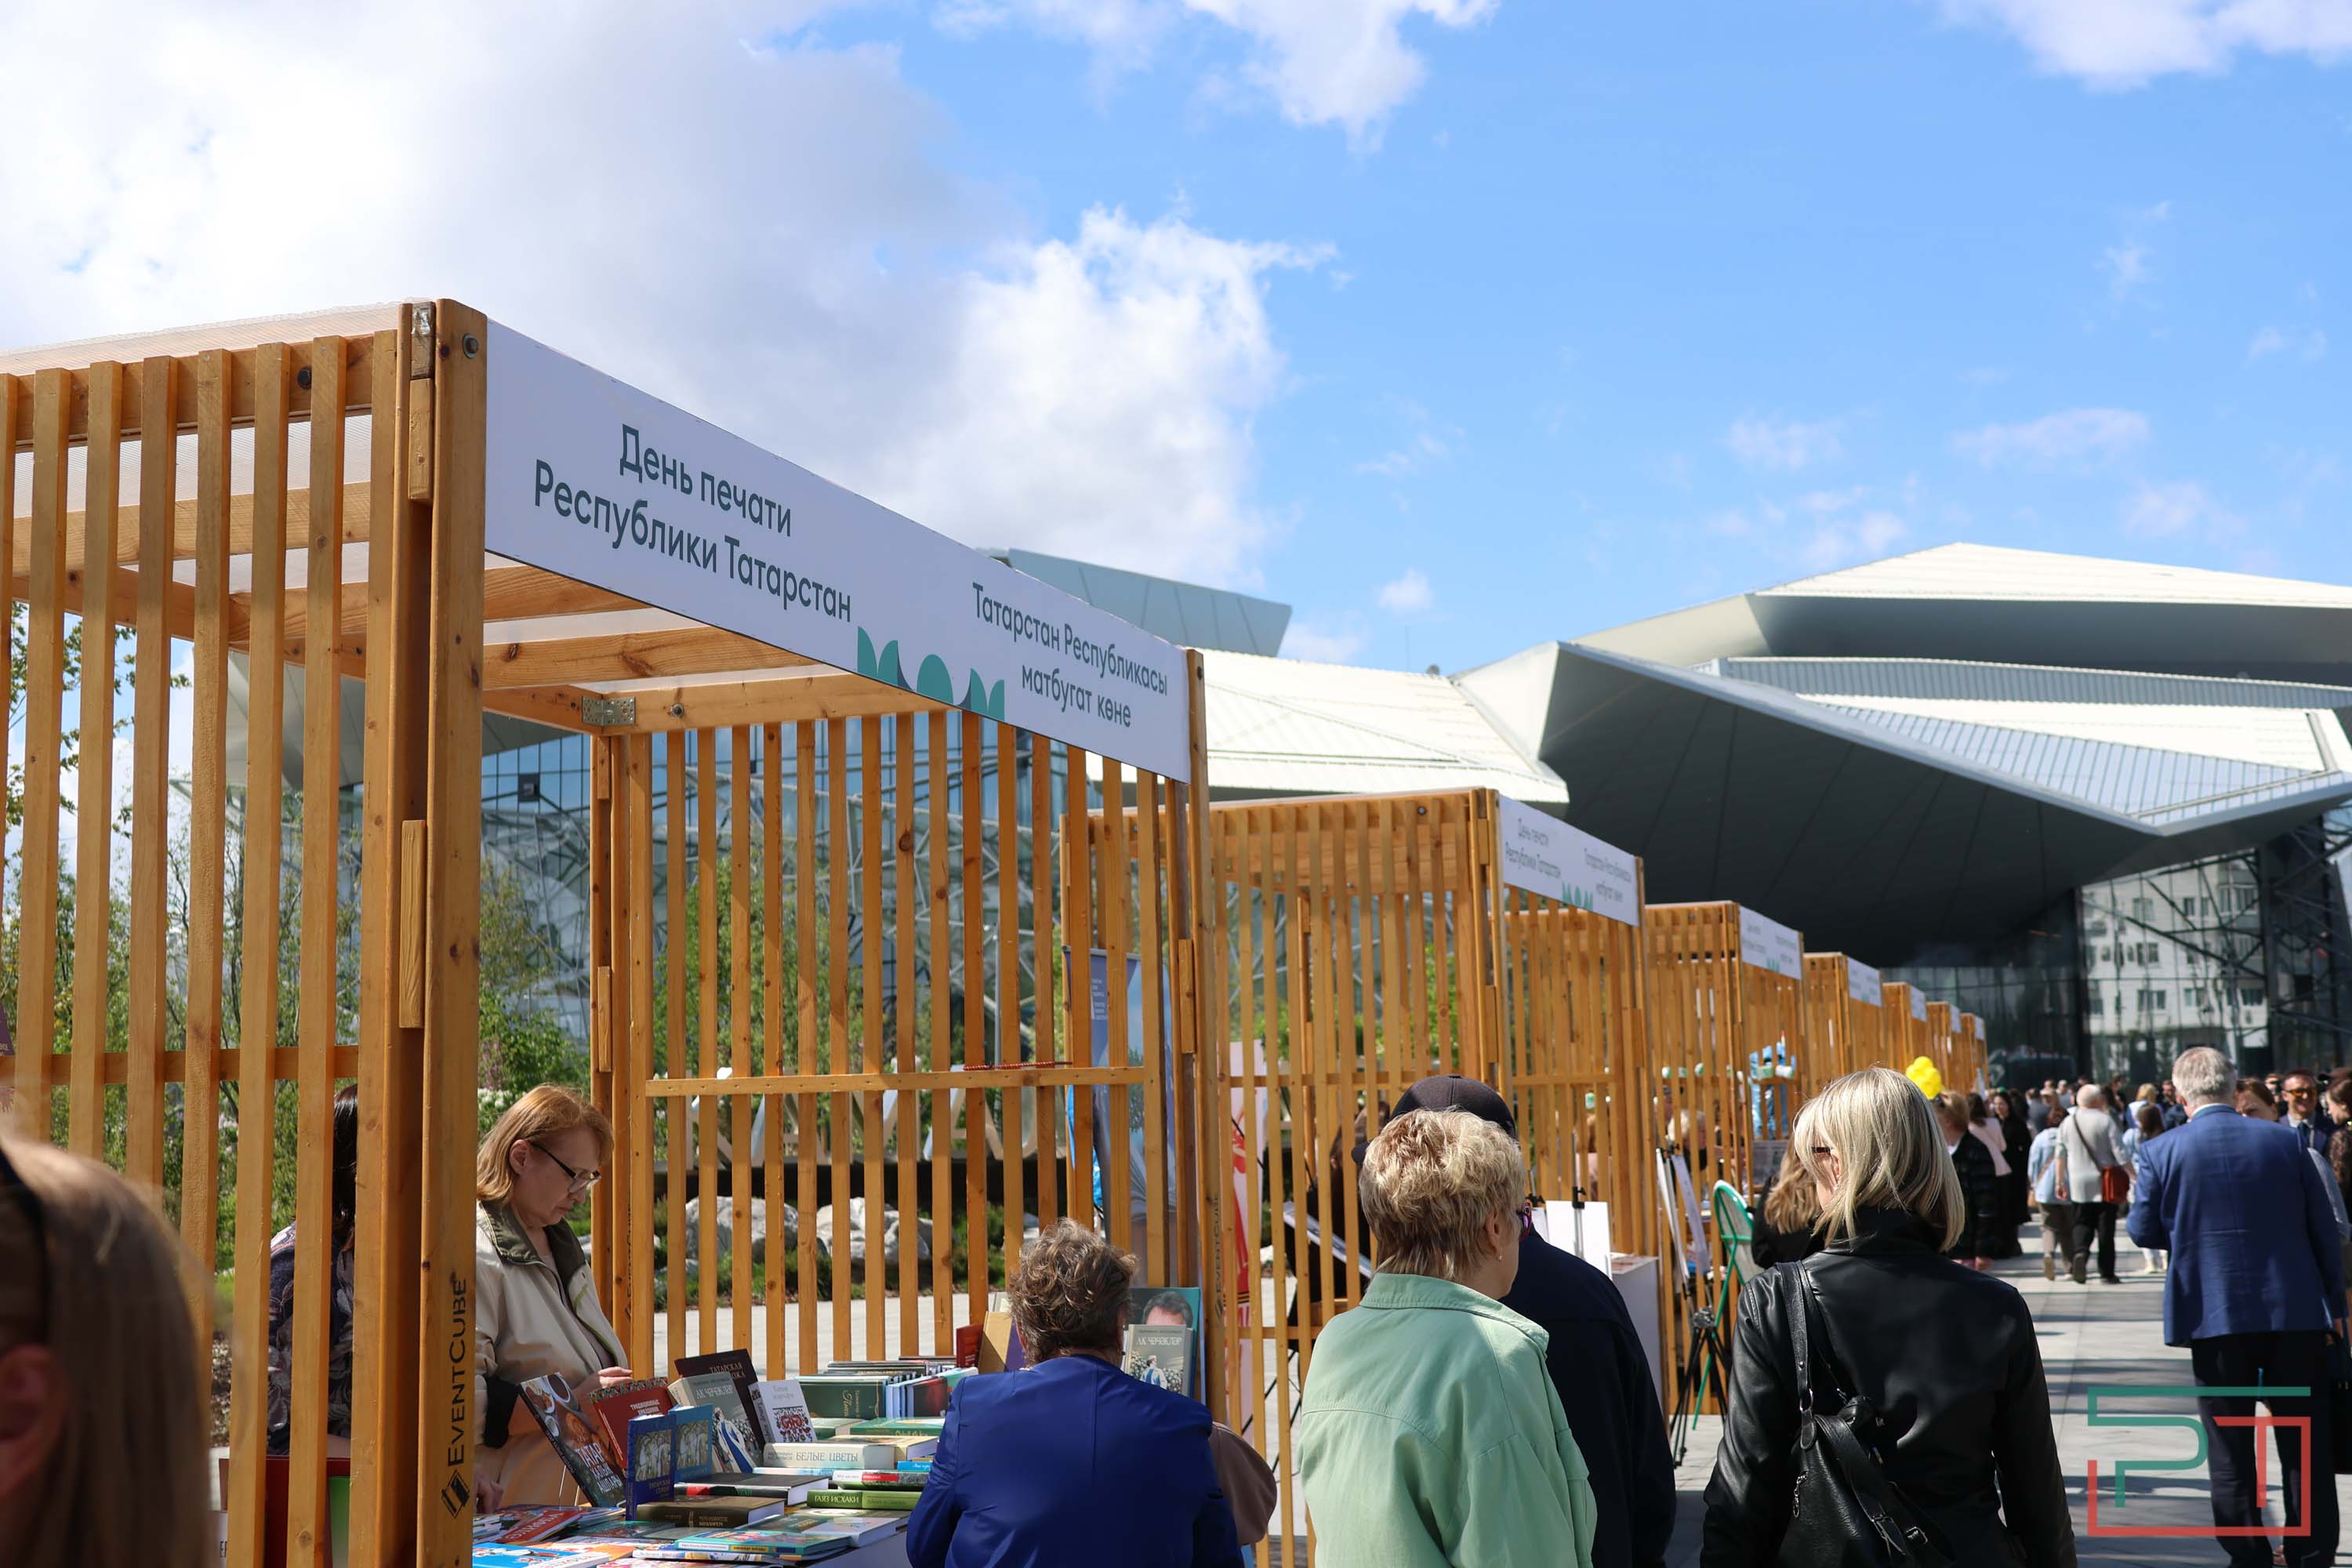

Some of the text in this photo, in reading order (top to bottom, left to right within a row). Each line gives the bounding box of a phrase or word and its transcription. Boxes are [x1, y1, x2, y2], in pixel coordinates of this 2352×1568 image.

[619, 424, 792, 537] День печати
[535, 459, 851, 623] Республики Татарстан
[972, 582, 1168, 696] Татарстан Республикасы
[1022, 664, 1131, 728] матбугат көне
[448, 1279, 466, 1466] EVENTCUBE
[576, 1443, 605, 1468] ТАТАР
[796, 1452, 825, 1461] БЕЛЫЕ
[829, 1452, 858, 1462] ЦВЕТЫ
[815, 1494, 829, 1503] ГАЯЗ
[830, 1494, 859, 1504] ИСХАКИ
